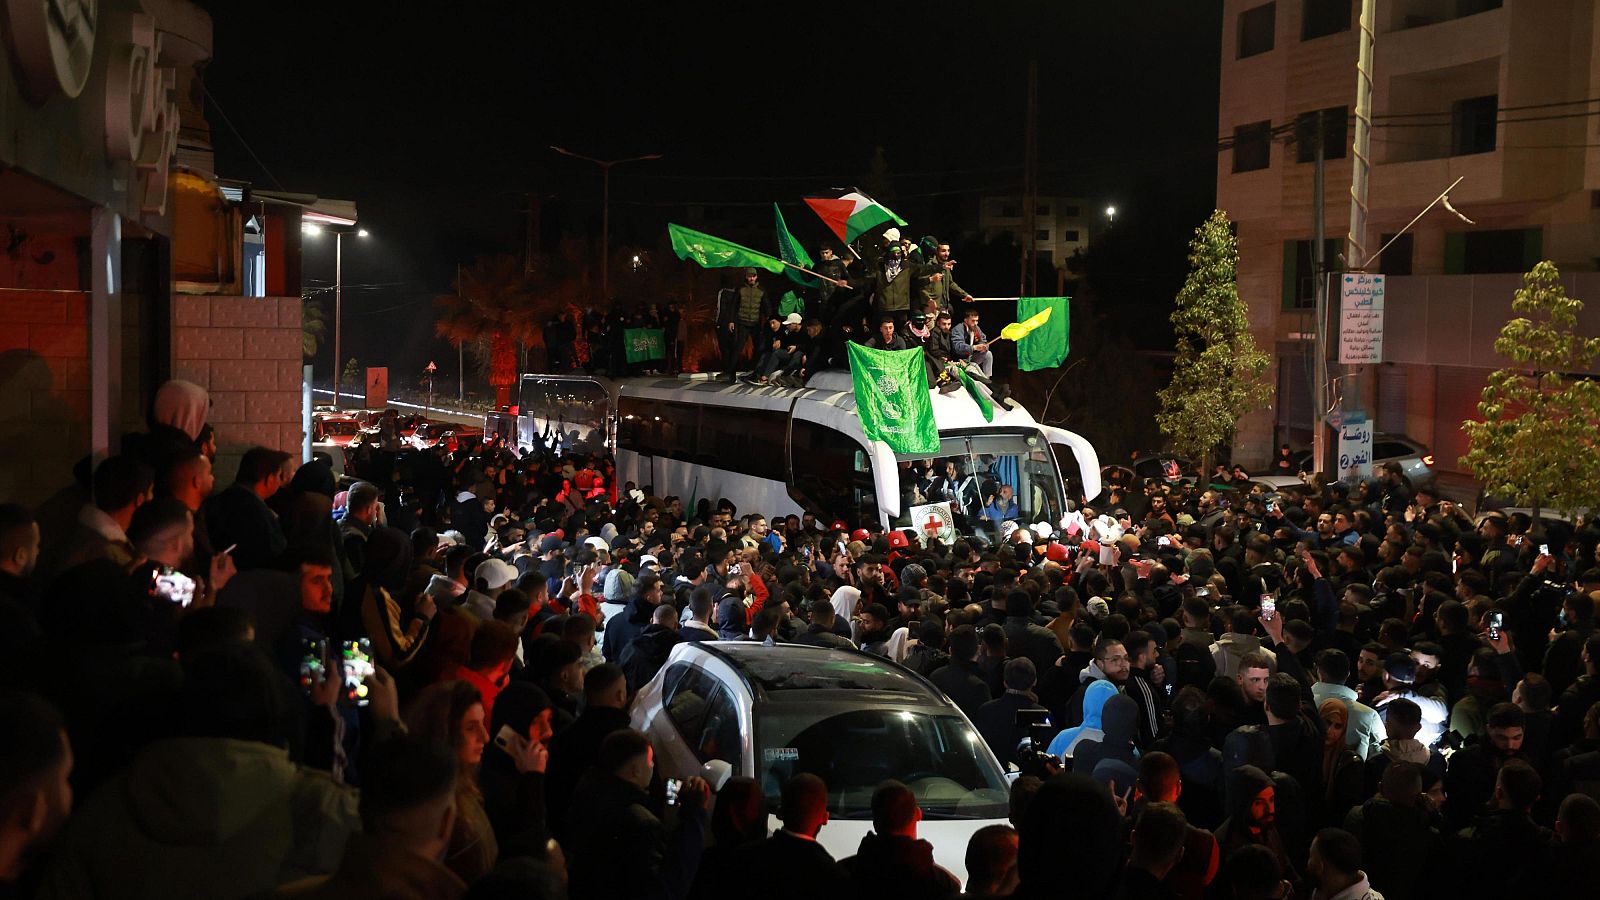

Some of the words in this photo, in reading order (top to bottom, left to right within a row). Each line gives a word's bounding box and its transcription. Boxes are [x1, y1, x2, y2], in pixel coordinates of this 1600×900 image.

[1358, 275, 1371, 284] مركز
[1343, 425, 1370, 444] روضة
[1350, 450, 1371, 468] الفجر
